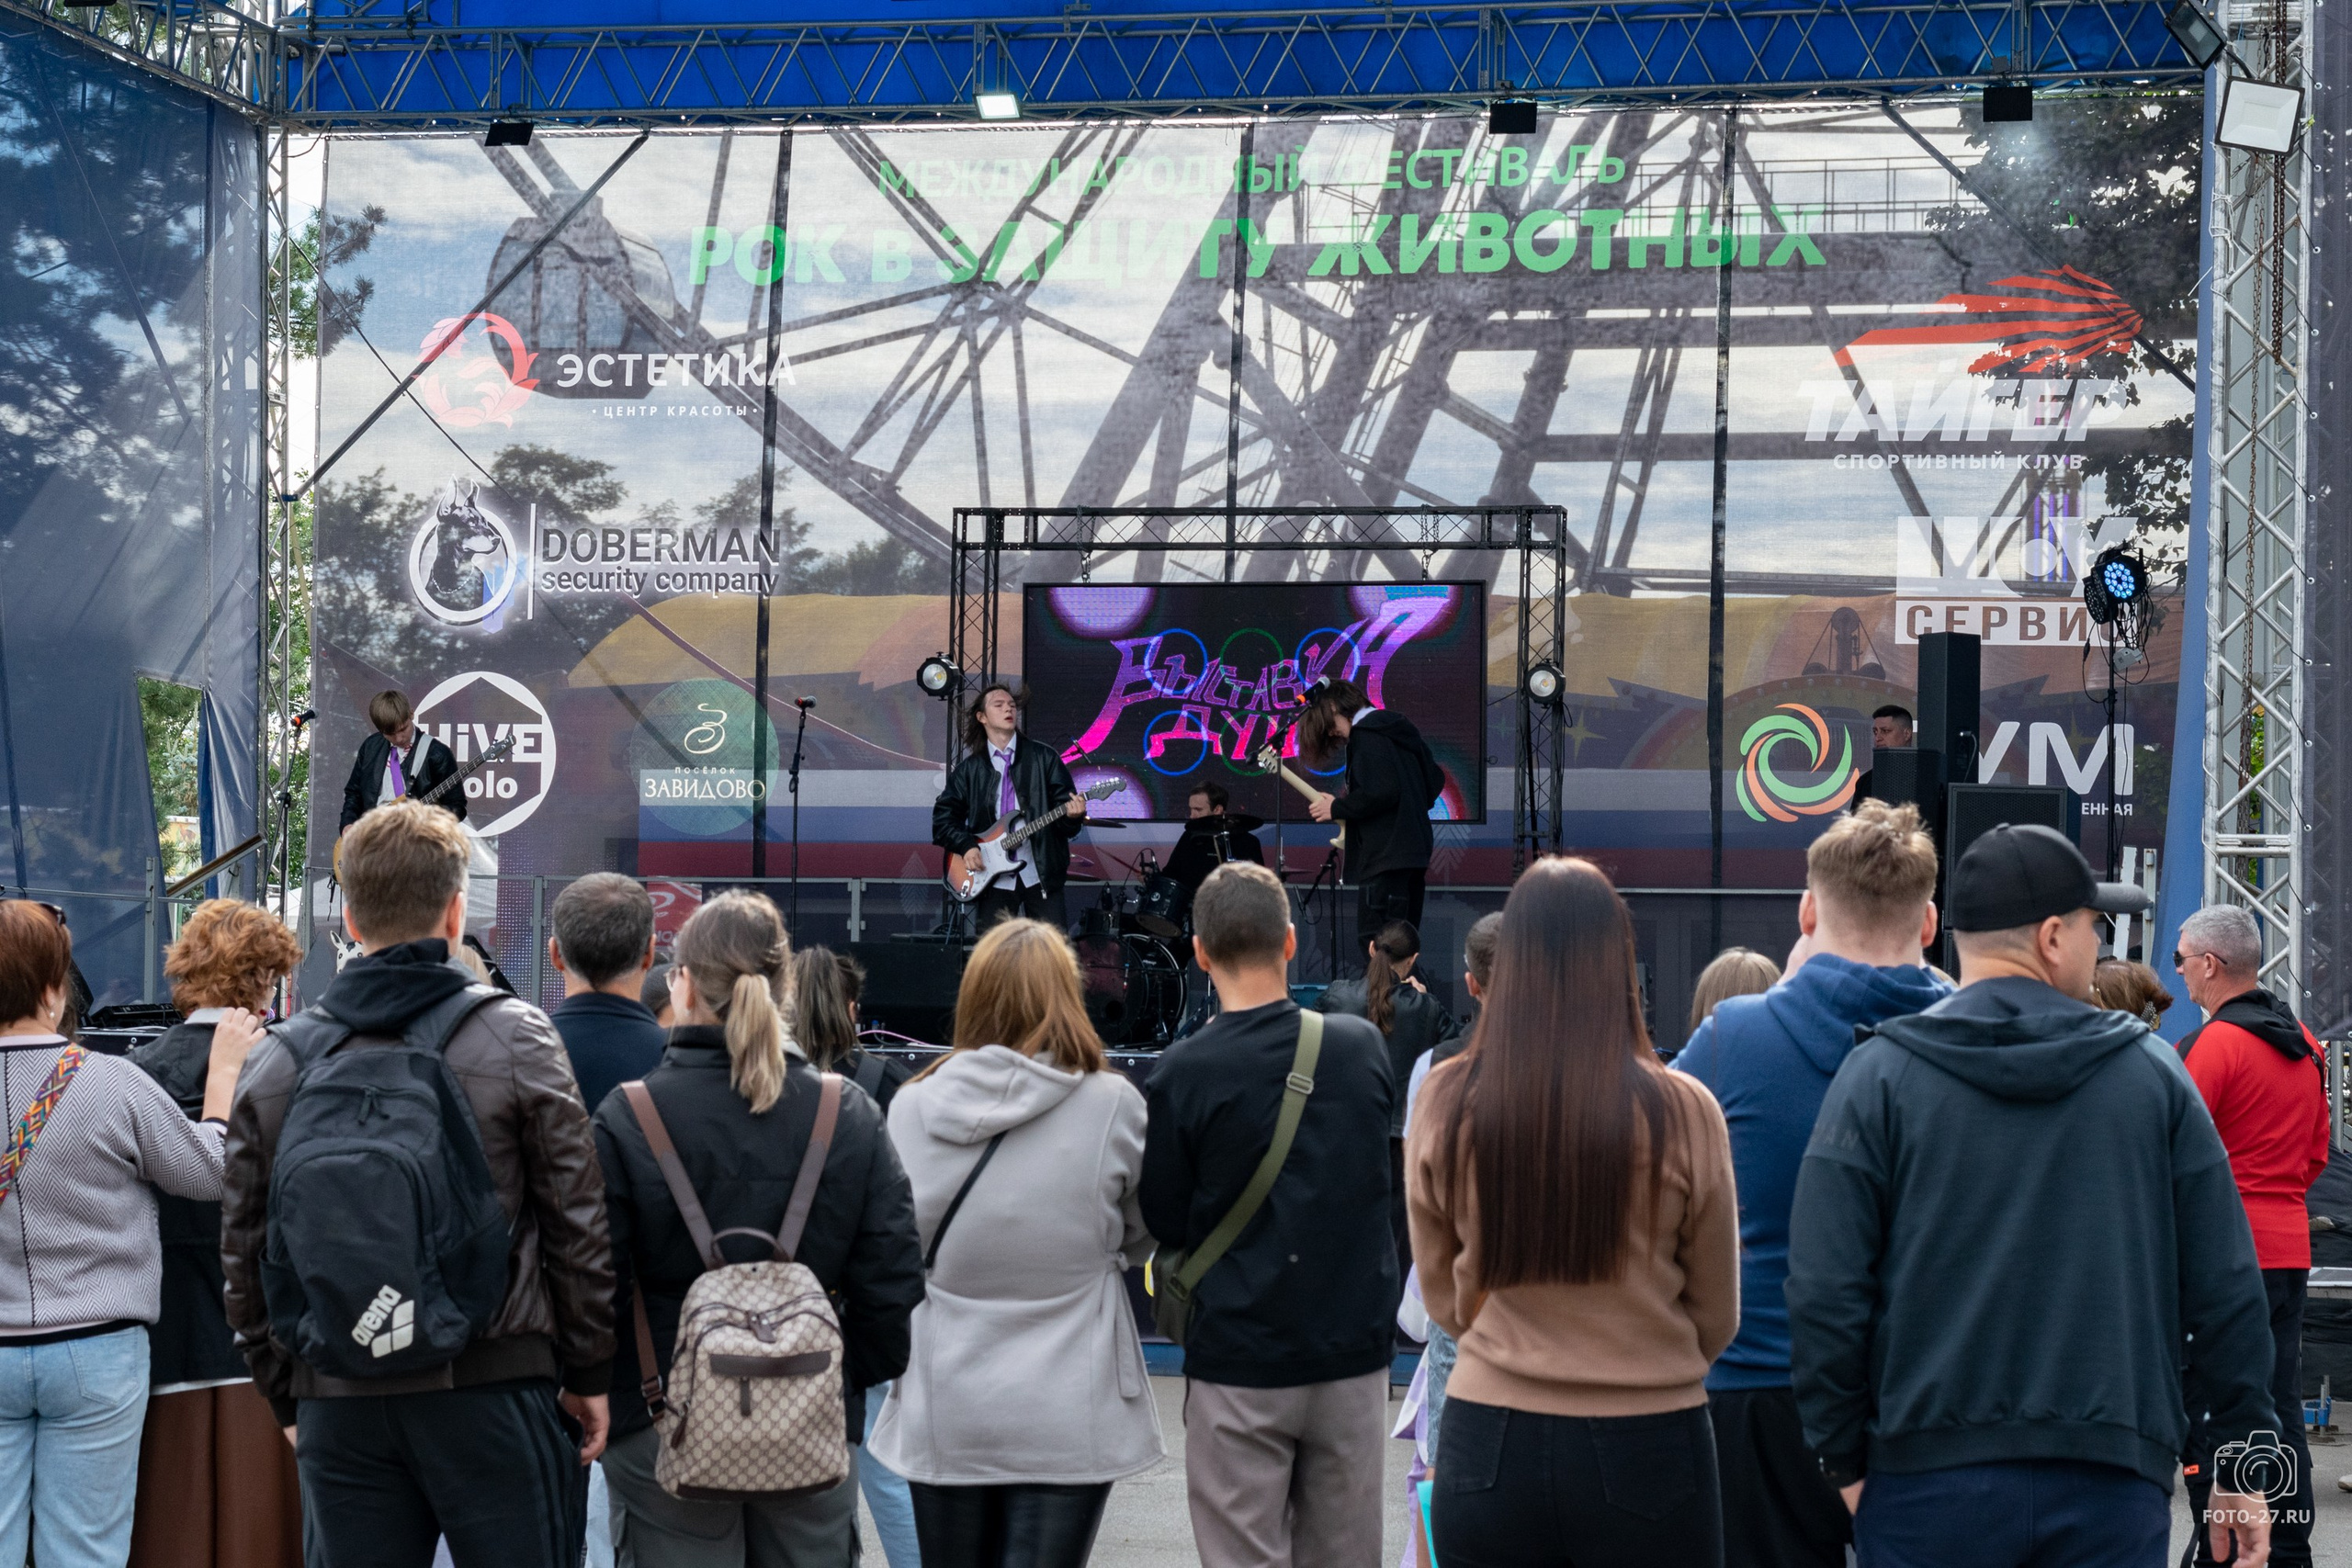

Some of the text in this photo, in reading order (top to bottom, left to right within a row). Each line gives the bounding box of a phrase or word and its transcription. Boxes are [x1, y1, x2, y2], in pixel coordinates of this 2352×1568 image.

[877, 145, 1319, 199] МЕЖДУНАРОДНЫЙ
[688, 223, 847, 287] РОК
[935, 216, 1287, 290] ЗАЩИТУ
[1307, 204, 1826, 276] ЖИВОТНЫХ
[556, 353, 797, 388] ЭСТЕТИКА
[604, 404, 748, 417] ЦЕНТР КРАСОТЫ
[1794, 359, 2128, 442] ТАЙГЕР
[1833, 449, 2084, 469] СПОРТИВНЫЙ КЛУБ
[542, 527, 781, 565] DOBERMAN
[541, 566, 780, 598] security company
[464, 771, 518, 798] olo
[644, 778, 765, 800] ЗАВИДОВО
[351, 1284, 402, 1347] arena
